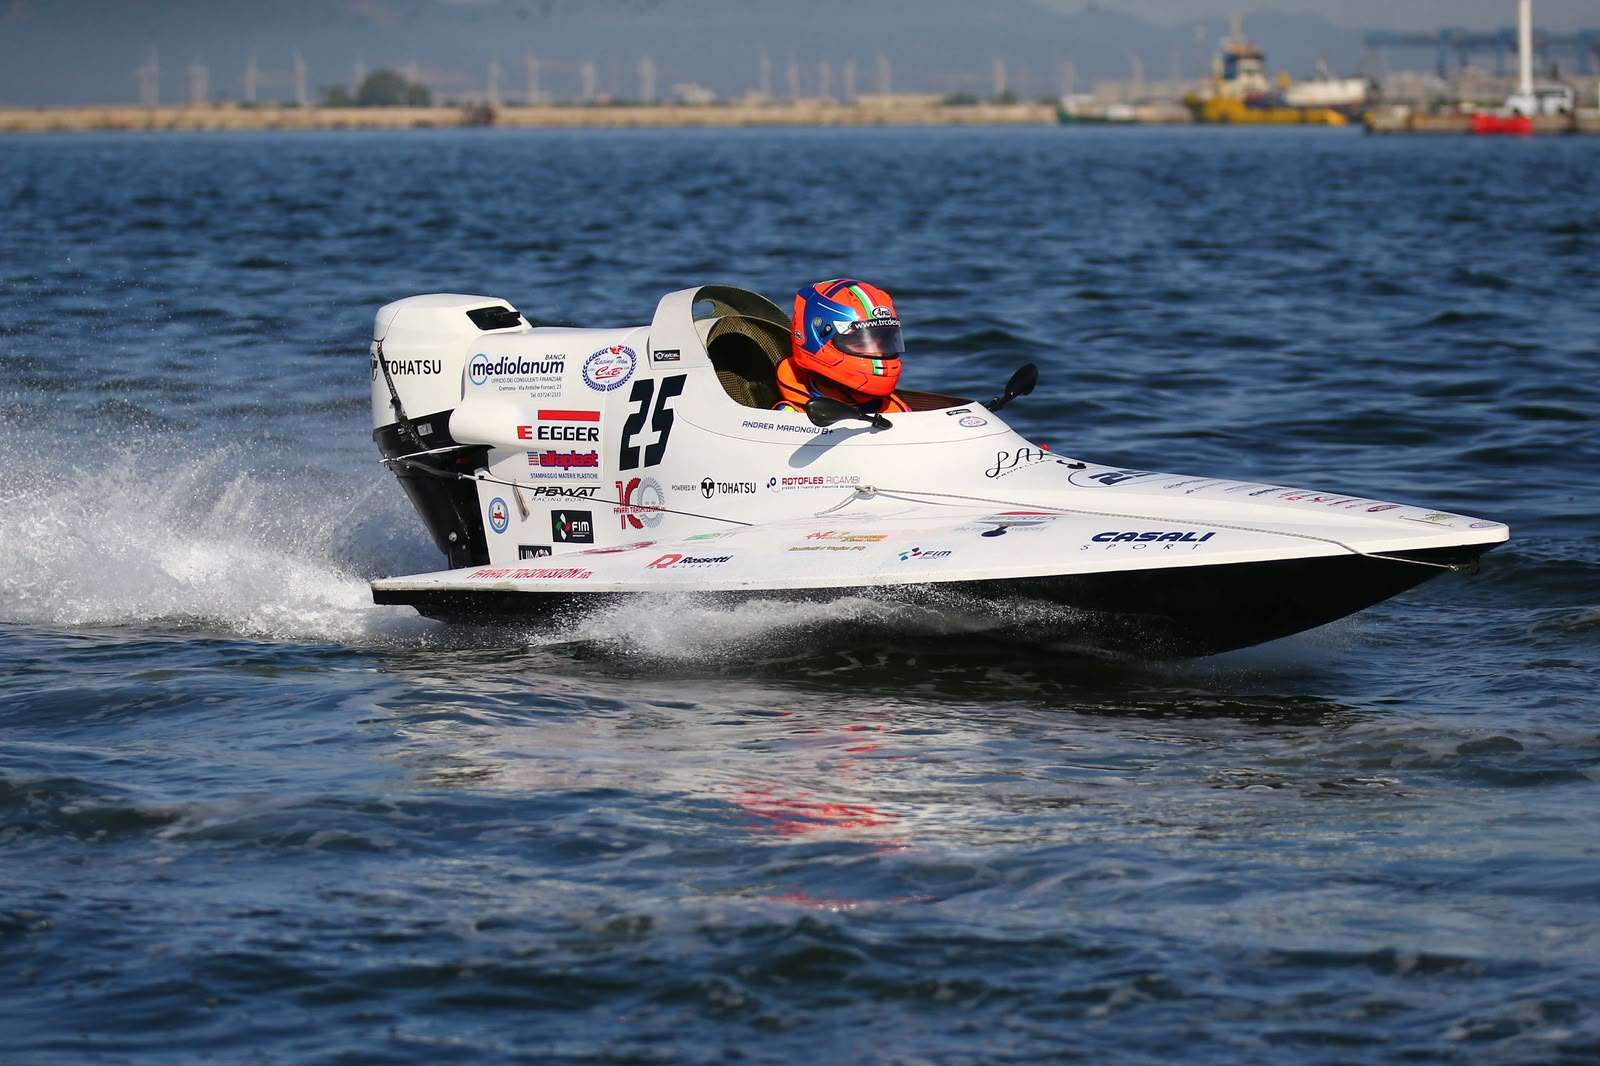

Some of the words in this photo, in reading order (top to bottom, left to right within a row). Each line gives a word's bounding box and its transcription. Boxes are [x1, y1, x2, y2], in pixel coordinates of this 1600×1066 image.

[386, 359, 442, 376] TOHATSU
[472, 356, 565, 376] mediolanum
[619, 373, 688, 471] 25
[742, 420, 774, 430] ANDREA
[776, 424, 820, 434] MARONGIU
[537, 426, 599, 442] EGGER
[717, 482, 757, 494] TOHATSU
[572, 521, 590, 532] FIM
[1091, 532, 1216, 542] CASALI
[679, 555, 734, 564] Rossetti
